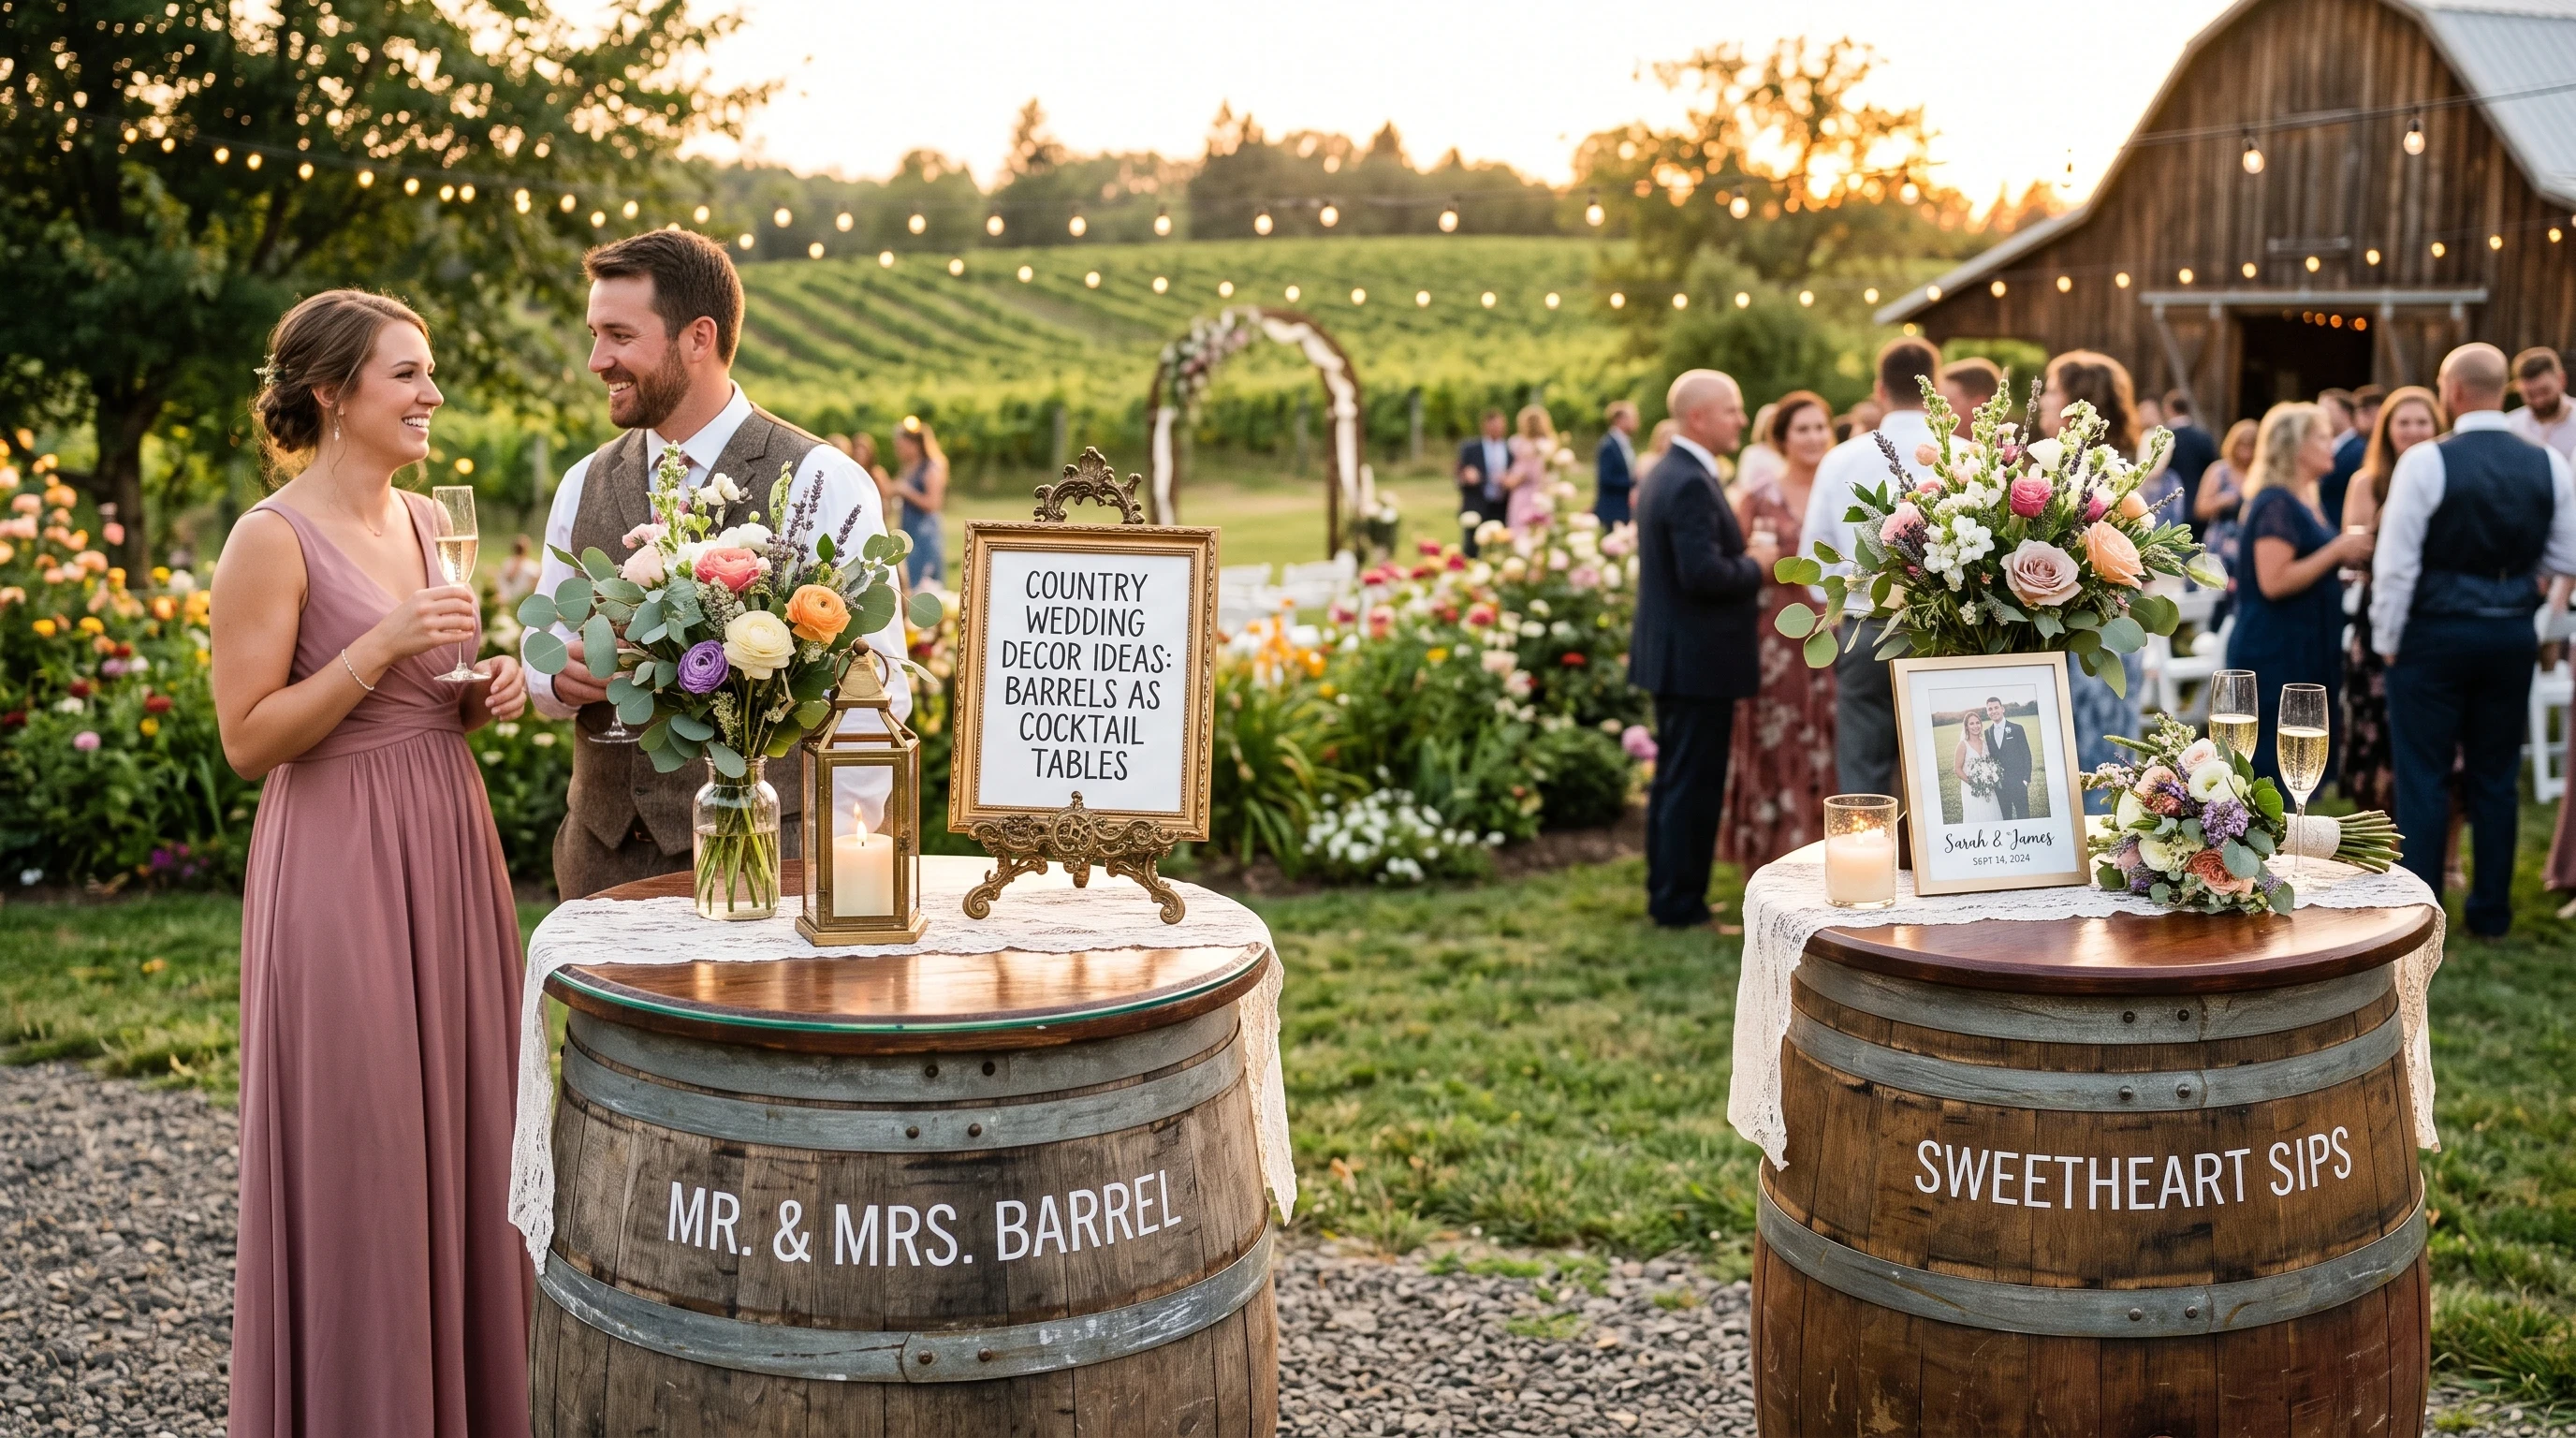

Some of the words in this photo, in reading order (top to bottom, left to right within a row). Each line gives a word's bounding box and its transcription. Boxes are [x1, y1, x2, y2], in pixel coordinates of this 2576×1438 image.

[1025, 570, 1149, 602] COUNTRY
[1026, 605, 1146, 637] WEDDING
[1002, 640, 1082, 671] DECOR
[1093, 643, 1172, 673] IDEAS:
[1005, 676, 1118, 709] BARRELS
[1127, 681, 1161, 710] AS
[1019, 712, 1145, 745] COCKTAIL
[1031, 747, 1128, 781] TABLES
[1944, 829, 1988, 854] Sarah
[1992, 829, 2003, 847] &
[2006, 829, 2055, 851] James
[1996, 855, 2008, 865] 14,
[2010, 853, 2030, 863] 2024
[1915, 1139, 2250, 1211] SWEETHEART
[2269, 1125, 2352, 1196] SIPS
[667, 1181, 752, 1256] MR.
[772, 1199, 812, 1263] &
[835, 1203, 973, 1267] MRS.
[996, 1169, 1181, 1262] BARREL
